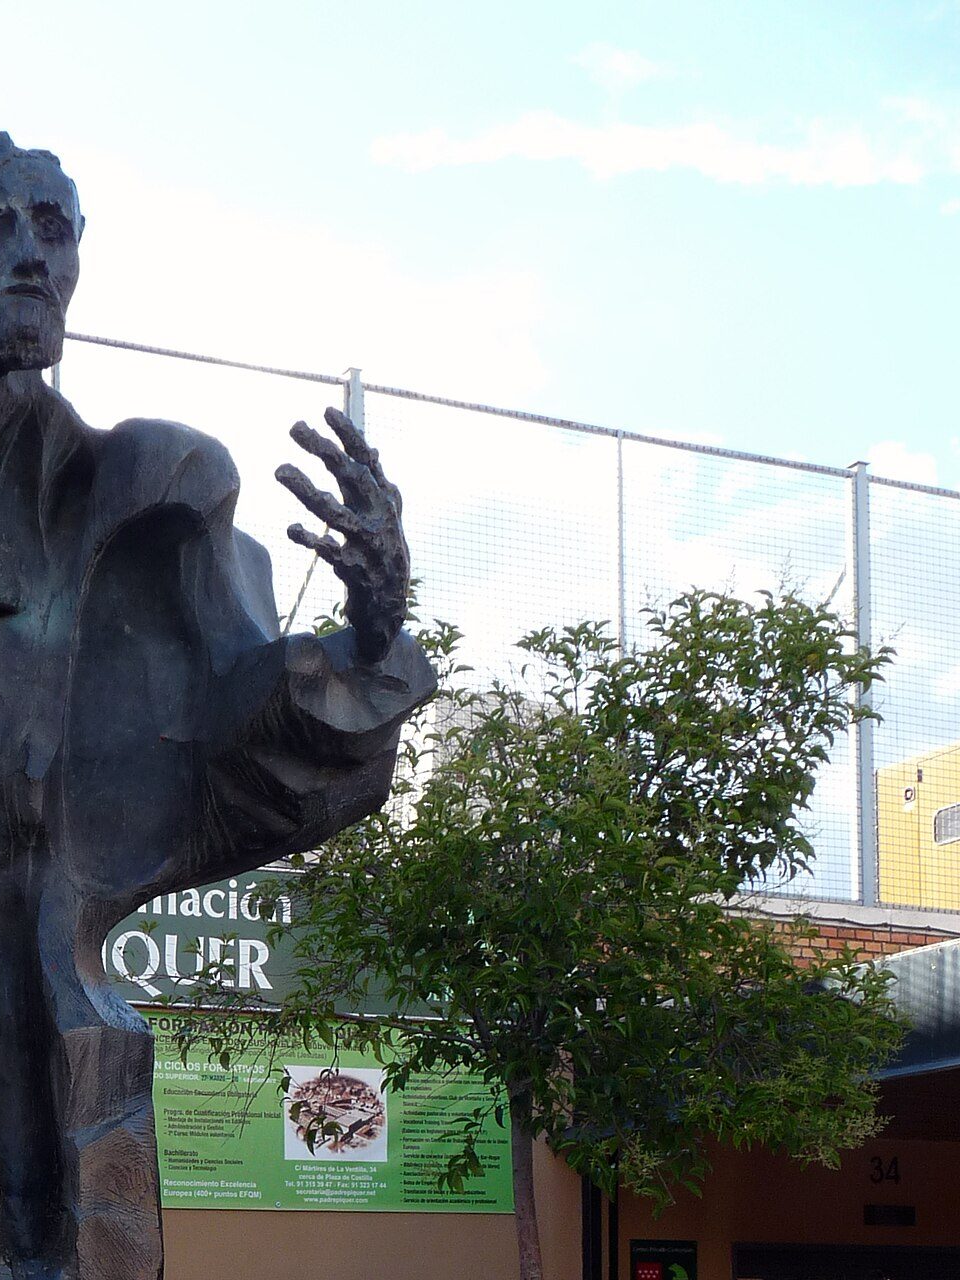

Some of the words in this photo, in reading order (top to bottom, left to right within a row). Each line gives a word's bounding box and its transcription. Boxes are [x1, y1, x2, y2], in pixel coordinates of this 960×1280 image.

[101, 930, 273, 998] QUER
[164, 1061, 201, 1072] CICLOS
[163, 1149, 199, 1157] Bachillerato
[869, 1156, 900, 1186] 34
[163, 1179, 220, 1188] Reconocimiento
[220, 1180, 257, 1188] Excelencia
[163, 1189, 193, 1198] Europea
[213, 1190, 238, 1199] puntos
[238, 1190, 262, 1199] EFQM)
